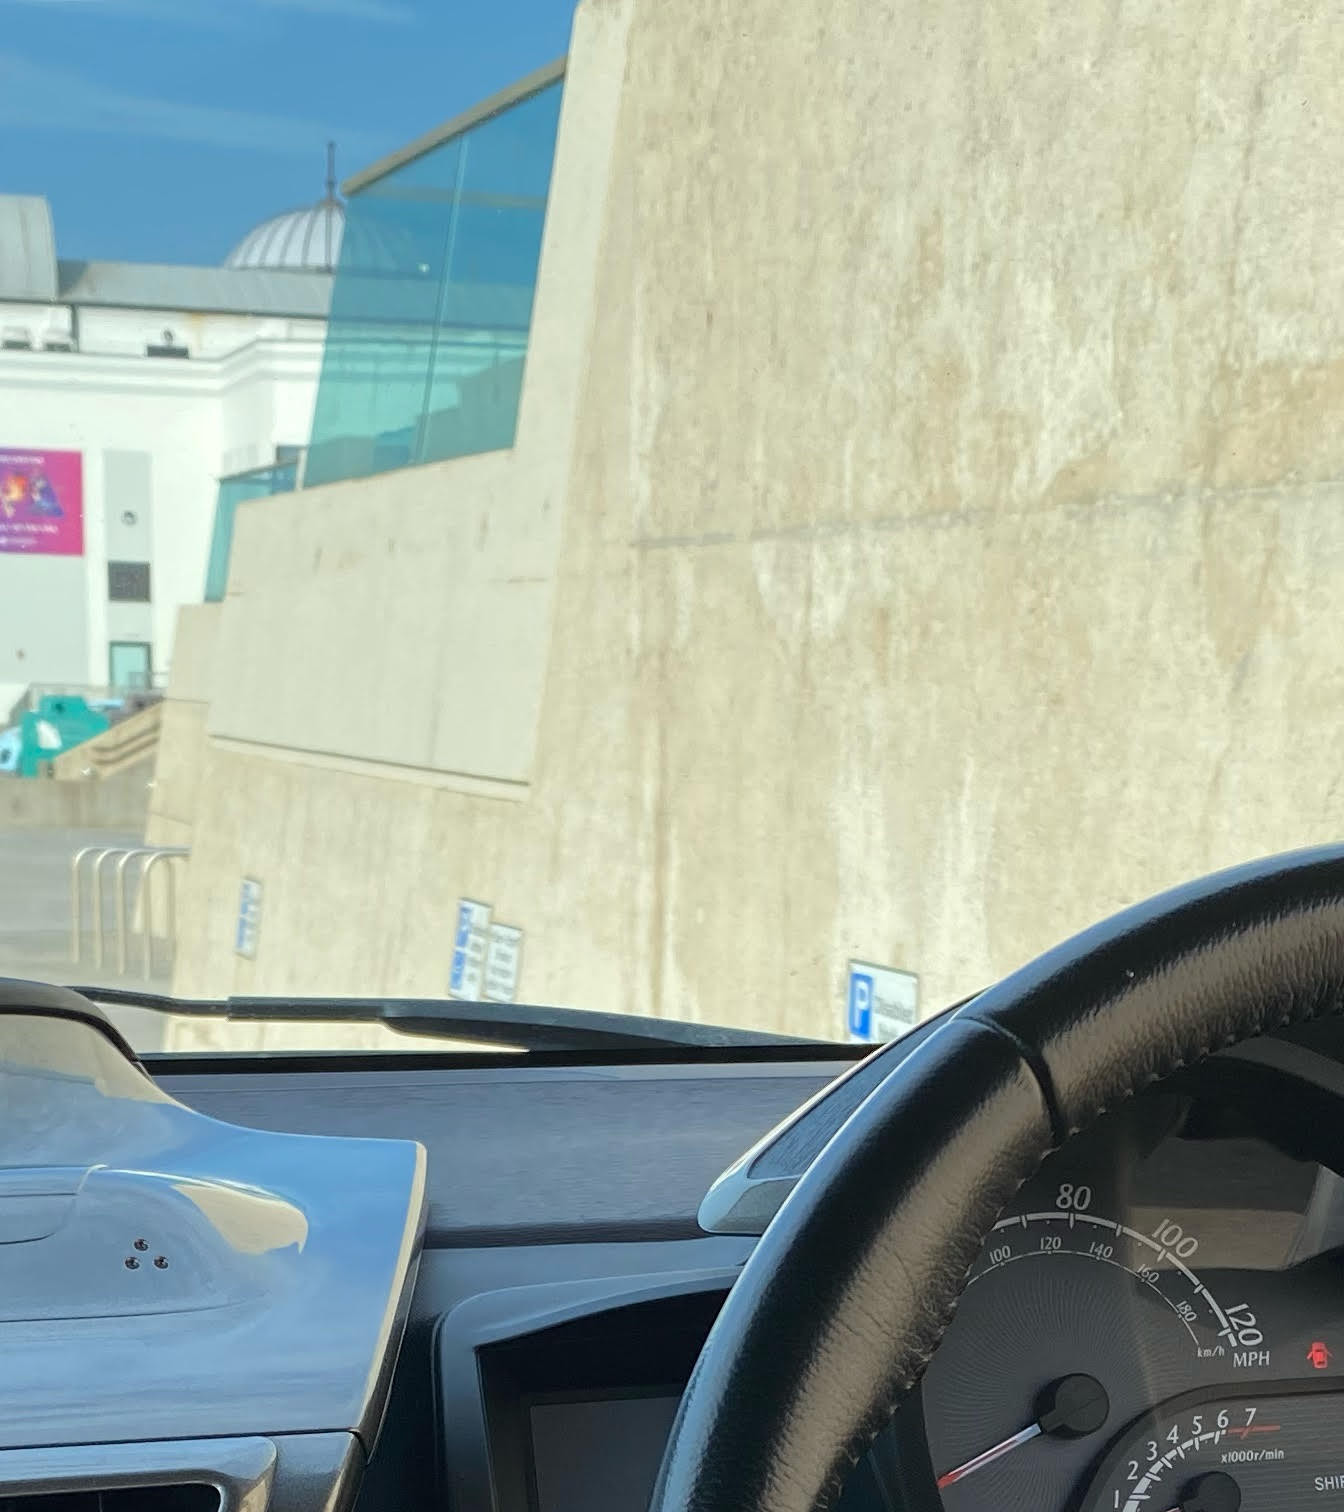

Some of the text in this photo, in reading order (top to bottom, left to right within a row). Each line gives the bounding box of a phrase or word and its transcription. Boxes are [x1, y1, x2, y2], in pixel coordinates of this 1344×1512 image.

[854, 980, 869, 1029] P
[1056, 1183, 1091, 1210] 80
[1041, 1237, 1061, 1249] 120
[1152, 1219, 1198, 1258] 100
[989, 1246, 1011, 1264] 100
[1090, 1242, 1113, 1258] 140
[1137, 1264, 1159, 1283] 160
[1176, 1300, 1197, 1322] 180
[1225, 1303, 1263, 1346] 120
[1197, 1346, 1225, 1358] km/h
[1233, 1350, 1270, 1368] MPH
[1128, 1460, 1138, 1480] 2
[1146, 1441, 1157, 1460] 3
[1167, 1424, 1179, 1443] 4
[1192, 1415, 1202, 1434] 5
[1217, 1409, 1229, 1428] 6
[1245, 1408, 1257, 1426] 7
